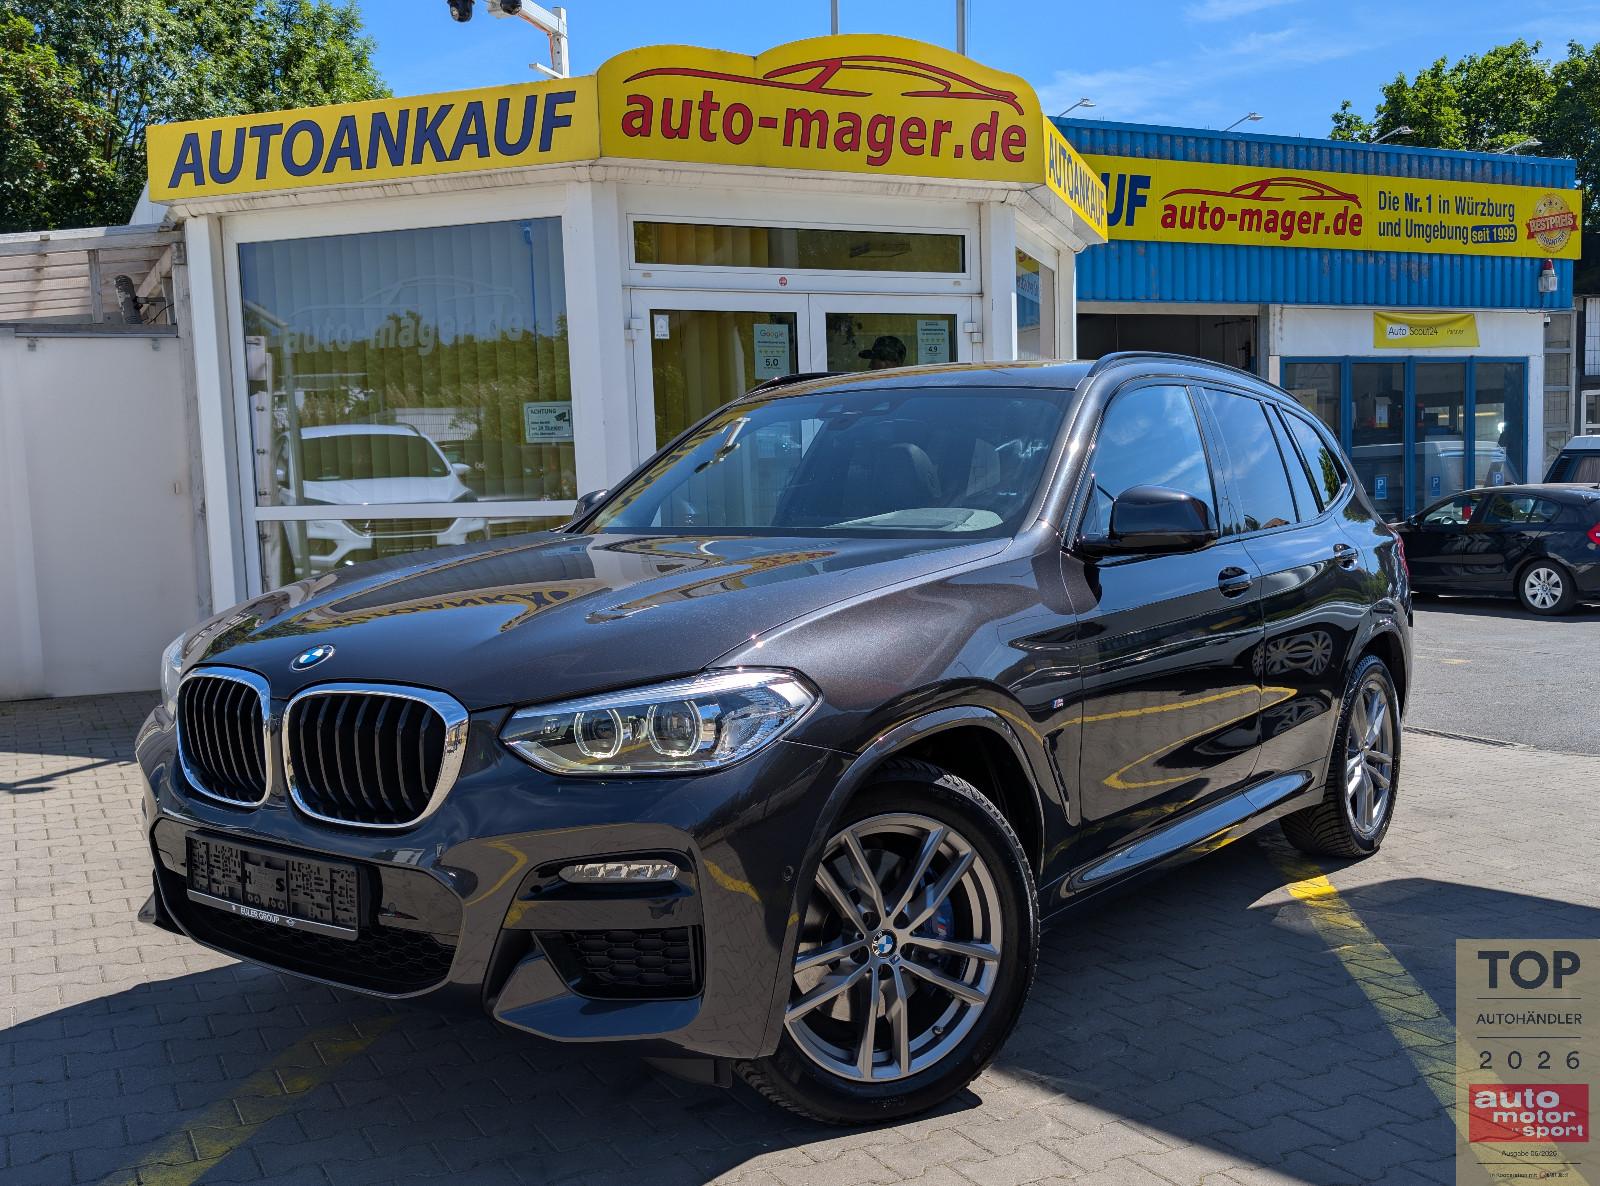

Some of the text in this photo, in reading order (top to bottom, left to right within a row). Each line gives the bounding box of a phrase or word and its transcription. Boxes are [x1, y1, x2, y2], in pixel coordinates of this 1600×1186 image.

[168, 91, 576, 188] AUTOANKAUF
[622, 90, 1027, 166] auto-mager.de
[1049, 132, 1105, 229] AUTOANKAUF
[1161, 201, 1363, 241] auto-mager.de
[1378, 191, 1515, 222] Die Nr. 1 in Würzburg
[1378, 218, 1516, 244] und Umgebung seit 1999
[1530, 213, 1573, 232] BESTPREIS
[1388, 326, 1407, 336] Auto
[1409, 326, 1439, 336] Scout24
[259, 912, 280, 924] GROUP
